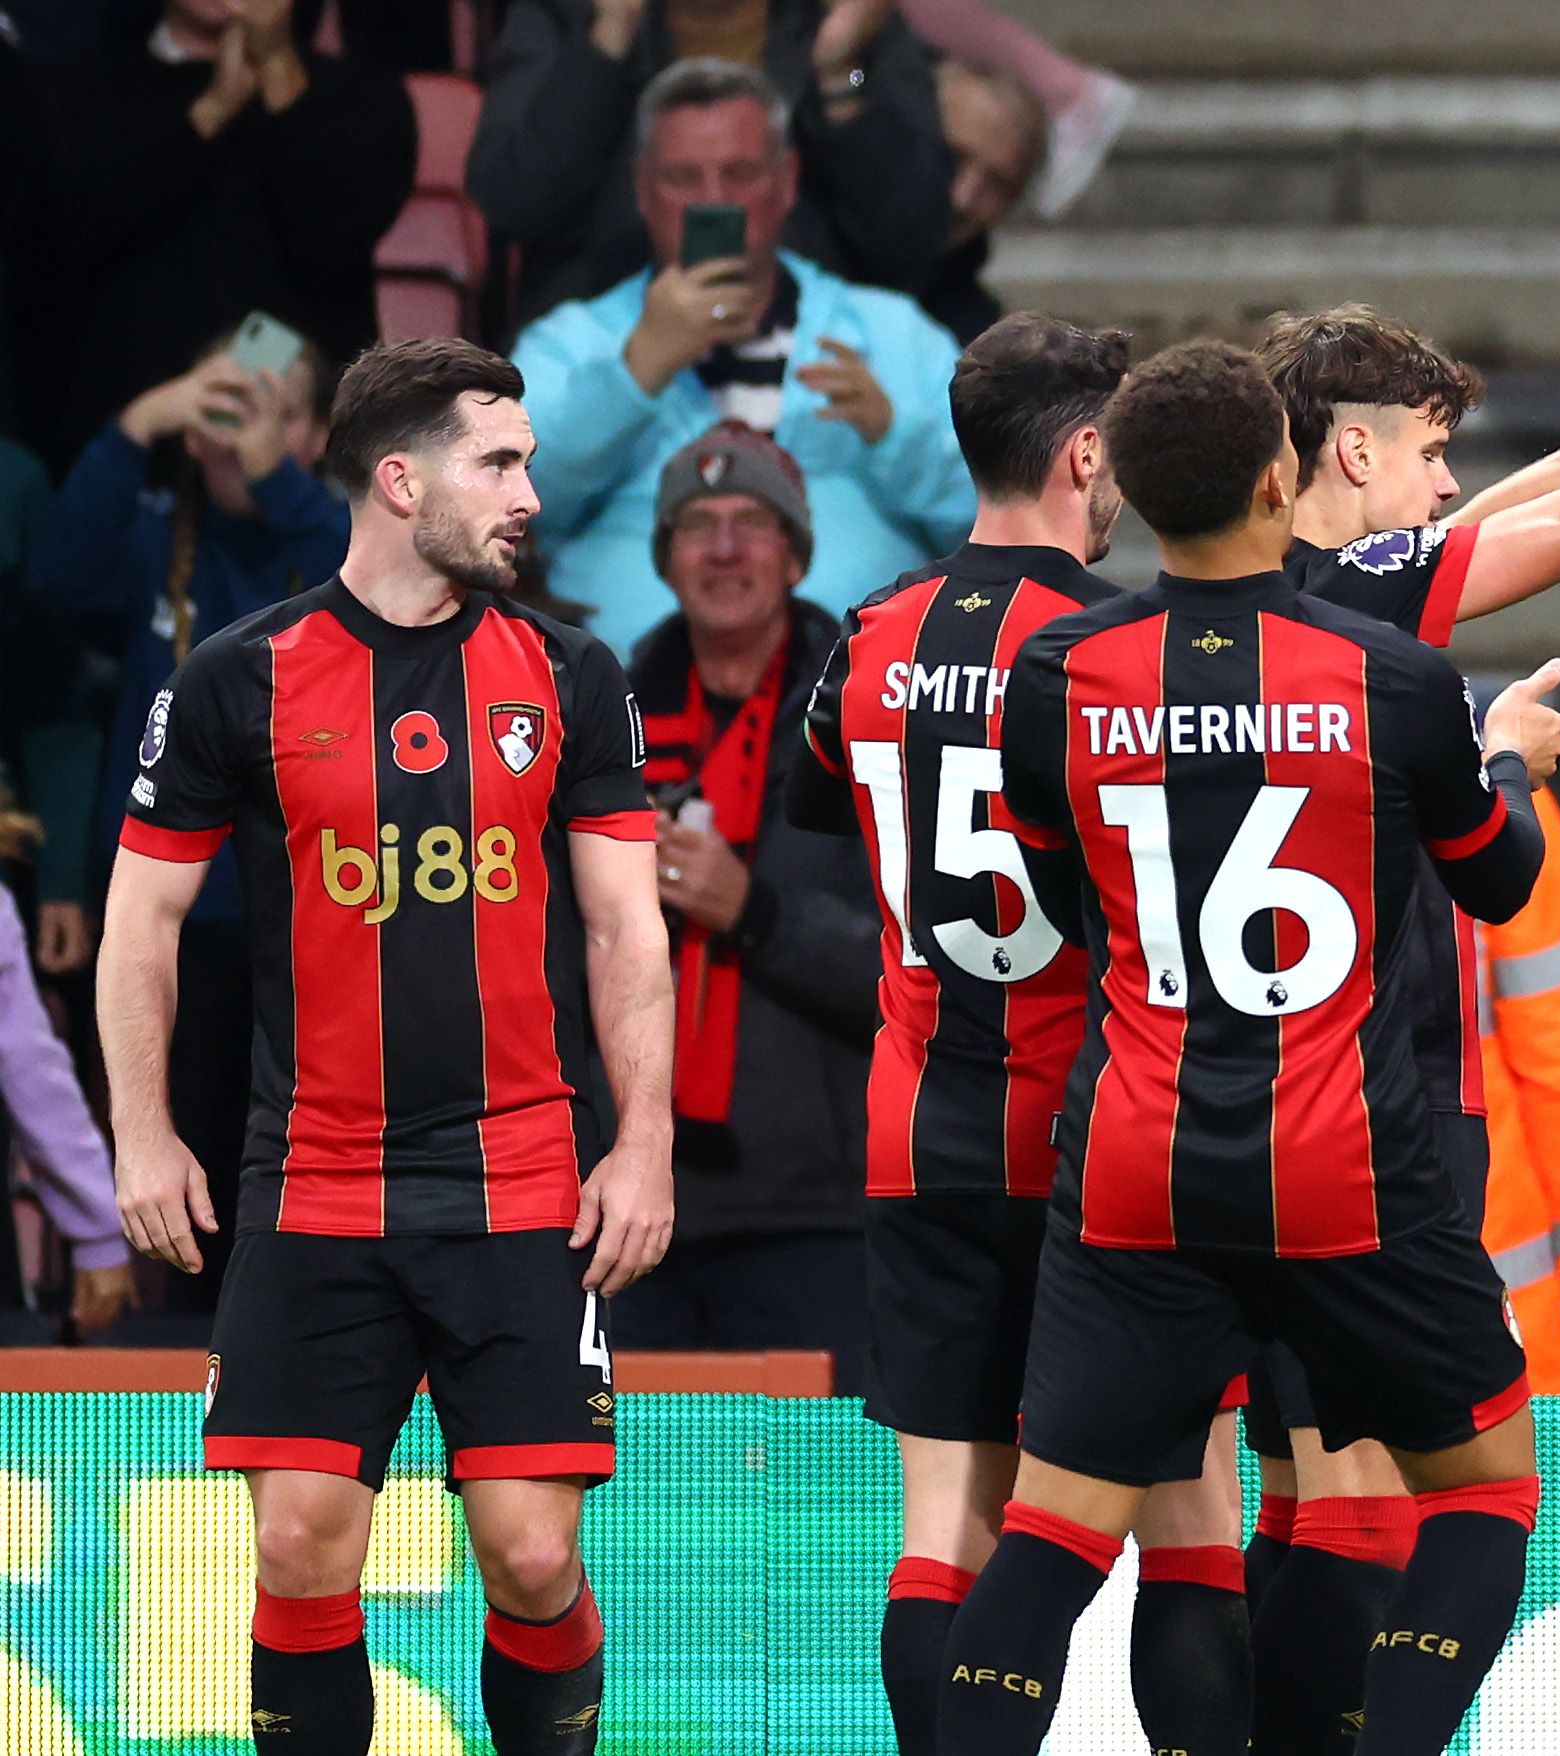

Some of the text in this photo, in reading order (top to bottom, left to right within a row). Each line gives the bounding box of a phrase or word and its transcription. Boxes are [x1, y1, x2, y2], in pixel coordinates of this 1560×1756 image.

[881, 661, 1011, 715] SMITH
[1081, 703, 1352, 756] TAVERNIER
[321, 824, 518, 925] bj88
[849, 740, 1064, 983] 15
[1097, 784, 1358, 1017] 16
[579, 1290, 612, 1385] 4
[951, 1664, 1042, 1699] AFCB
[1369, 1630, 1461, 1660] AFCB
